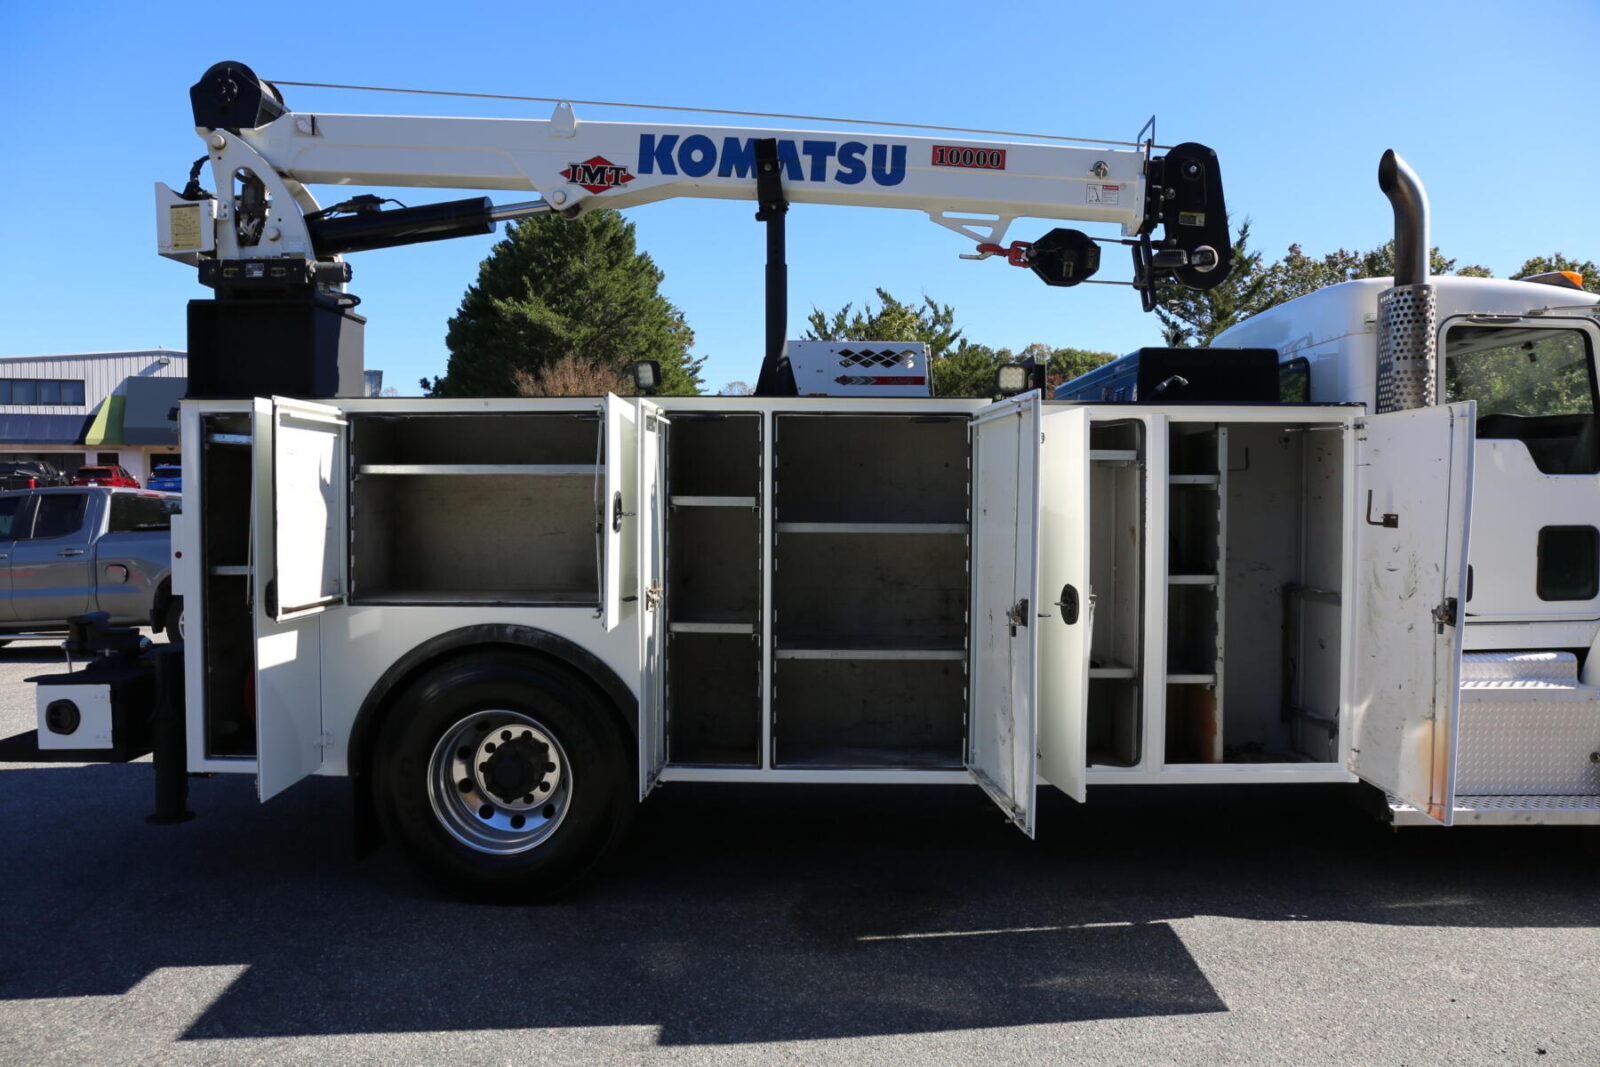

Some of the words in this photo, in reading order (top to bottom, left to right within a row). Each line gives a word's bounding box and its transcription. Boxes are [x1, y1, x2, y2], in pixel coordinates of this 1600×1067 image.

[638, 133, 908, 187] KOMATSU
[936, 147, 1002, 168] 10000
[567, 163, 628, 187] IMT
